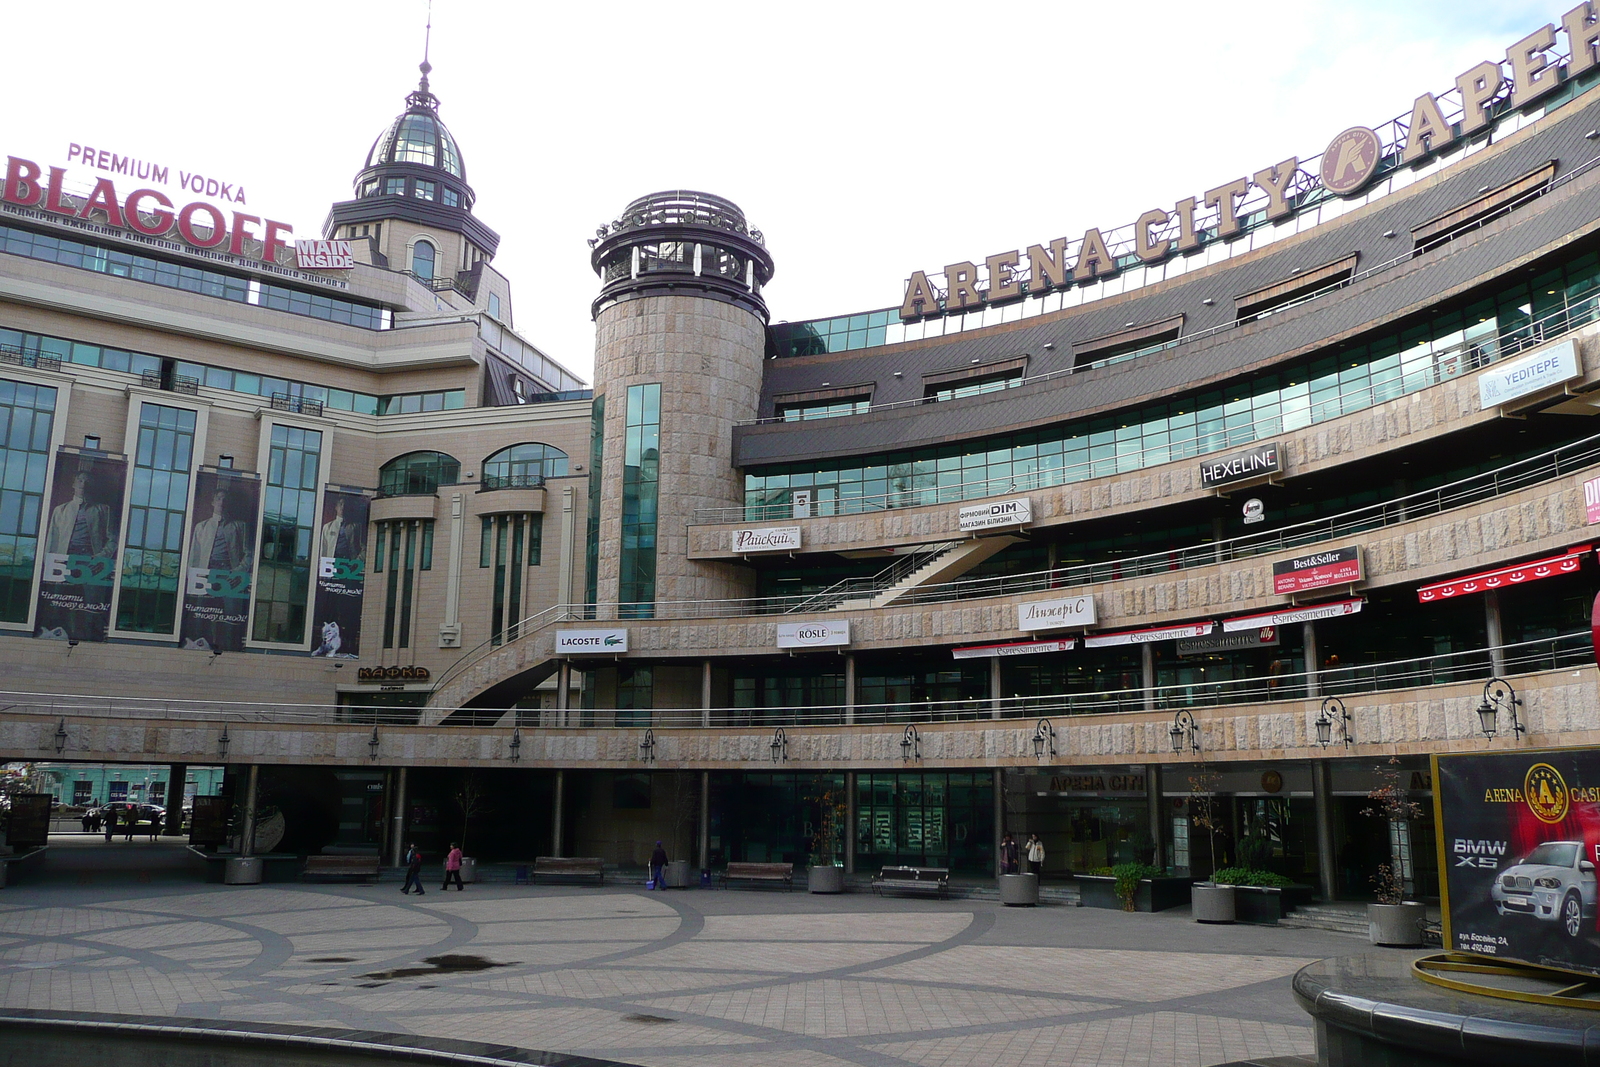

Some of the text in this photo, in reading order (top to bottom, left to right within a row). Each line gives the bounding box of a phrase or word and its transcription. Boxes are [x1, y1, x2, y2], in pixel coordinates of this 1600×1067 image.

[67, 142, 247, 206] PREMIUM VODKA
[1, 155, 294, 263] BLAGOFF
[900, 156, 1299, 319] ARENA CITY
[3, 204, 347, 290] НАДМІРНЕ ВЖИВАННЯ АЛКОГОЛЮ ШКІДЛИВЕ ДЛЯ ВАШОГО ЗДОРОВ'Я
[295, 240, 352, 255] MAIN
[299, 254, 354, 268] INSIDE
[1504, 357, 1560, 385] YEDITEPE
[1202, 450, 1276, 482] HEXELINE
[960, 508, 990, 519] ФІРМОВИЙ
[991, 503, 1017, 515] DIM
[960, 516, 1012, 528] МАГАЗИН БІЛИЗНИ
[739, 530, 790, 547] Райский
[1293, 552, 1340, 569] Best&Seller
[41, 591, 84, 602] Читати
[50, 600, 77, 610] знову
[1026, 602, 1073, 619] Лінжері
[1272, 607, 1337, 625] espressamente
[799, 628, 827, 639] RÖSLE
[1130, 628, 1189, 642] espressamente
[1260, 626, 1274, 640] illy
[561, 637, 600, 646] LACOSTE
[359, 667, 429, 678] КАФКА
[1484, 788, 1525, 803] ARENA
[1453, 838, 1507, 856] BMW
[1454, 855, 1499, 869] X5
